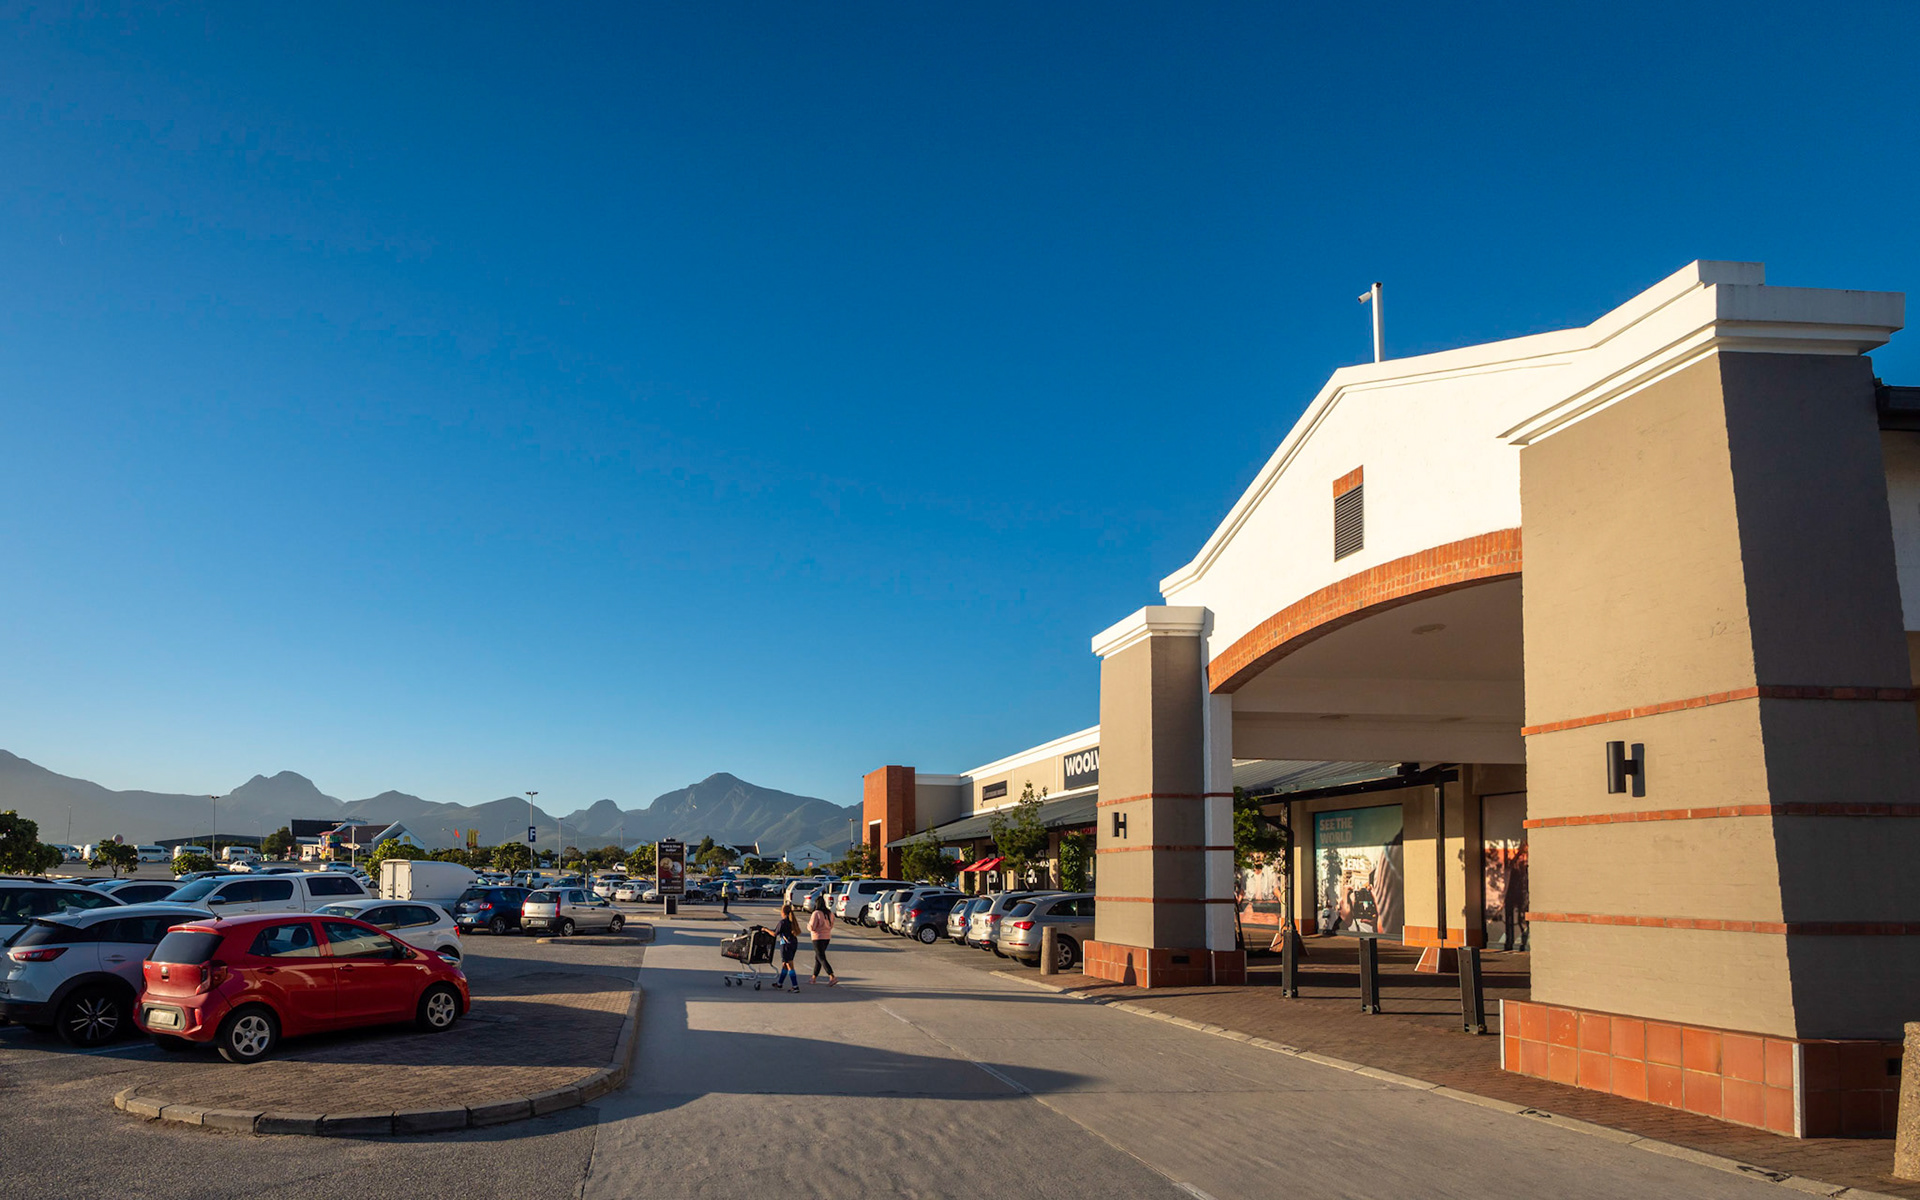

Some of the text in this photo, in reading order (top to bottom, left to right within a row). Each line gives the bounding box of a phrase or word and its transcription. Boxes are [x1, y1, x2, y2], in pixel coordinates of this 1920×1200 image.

[1320, 817, 1353, 831] SEE THE
[530, 828, 536, 840] F
[1320, 831, 1351, 844] WORLD
[1341, 857, 1366, 870] LENS
